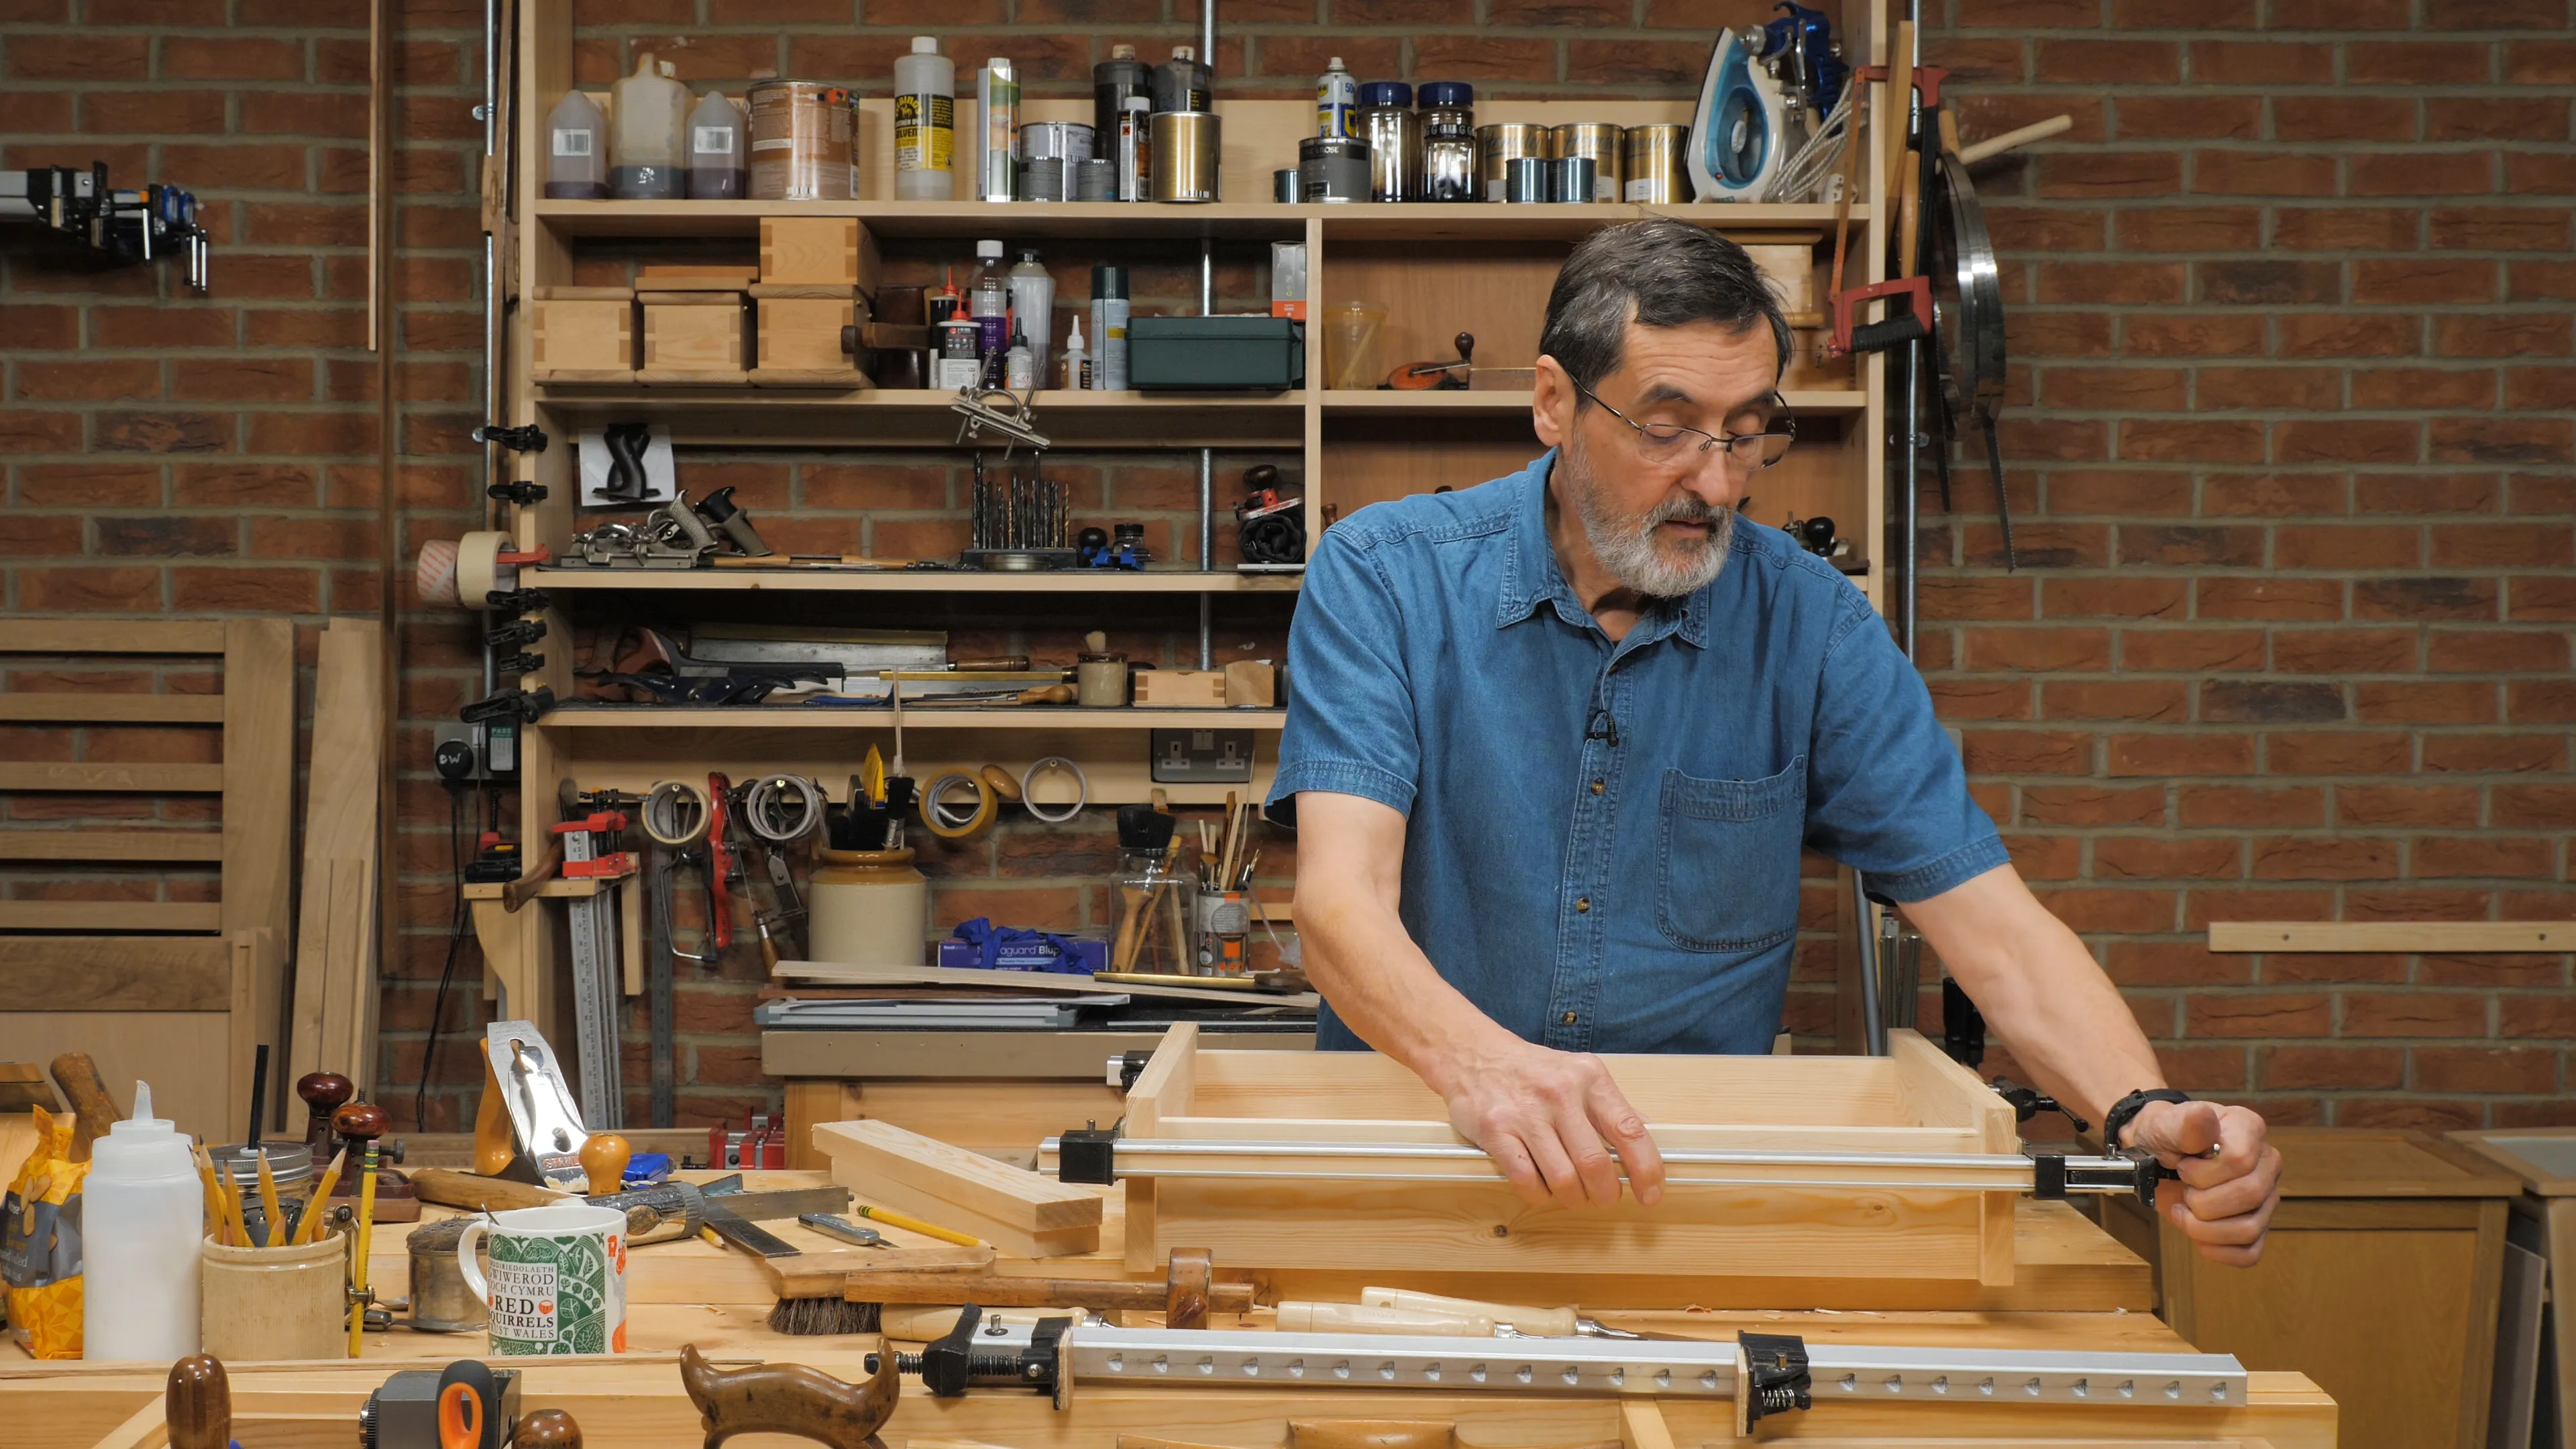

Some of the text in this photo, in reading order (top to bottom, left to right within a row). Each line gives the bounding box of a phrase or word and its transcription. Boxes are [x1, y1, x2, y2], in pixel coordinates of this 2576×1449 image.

[542, 1156, 580, 1169] STANL
[488, 1267, 554, 1285] GWIWEROD
[511, 1285, 554, 1297] CYMRU
[495, 1295, 535, 1315] RED
[489, 1322, 554, 1339] RUST WALES
